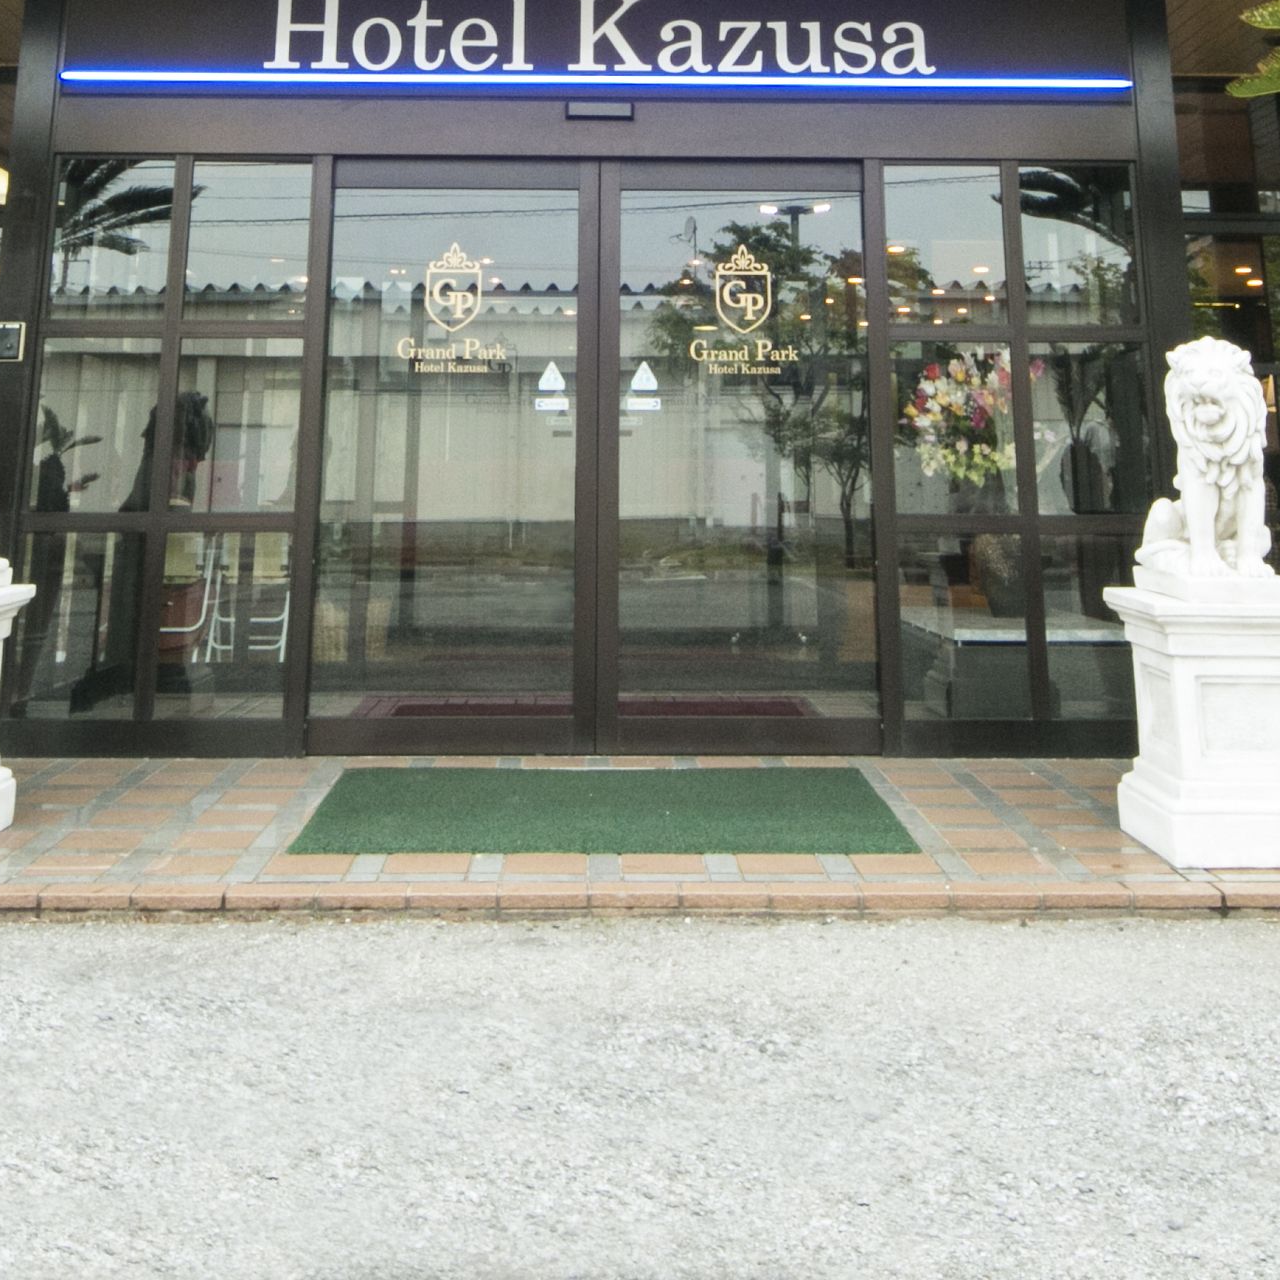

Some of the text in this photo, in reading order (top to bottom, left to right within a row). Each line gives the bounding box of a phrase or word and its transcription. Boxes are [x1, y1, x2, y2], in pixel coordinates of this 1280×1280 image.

[433, 278, 474, 319] GP
[722, 280, 765, 321] GP
[396, 337, 507, 360] Grand Park
[689, 339, 799, 361] Grand Park
[414, 361, 444, 374] Hotel
[448, 362, 488, 374] Kazusa
[708, 363, 782, 375] Hotel Kazusa
